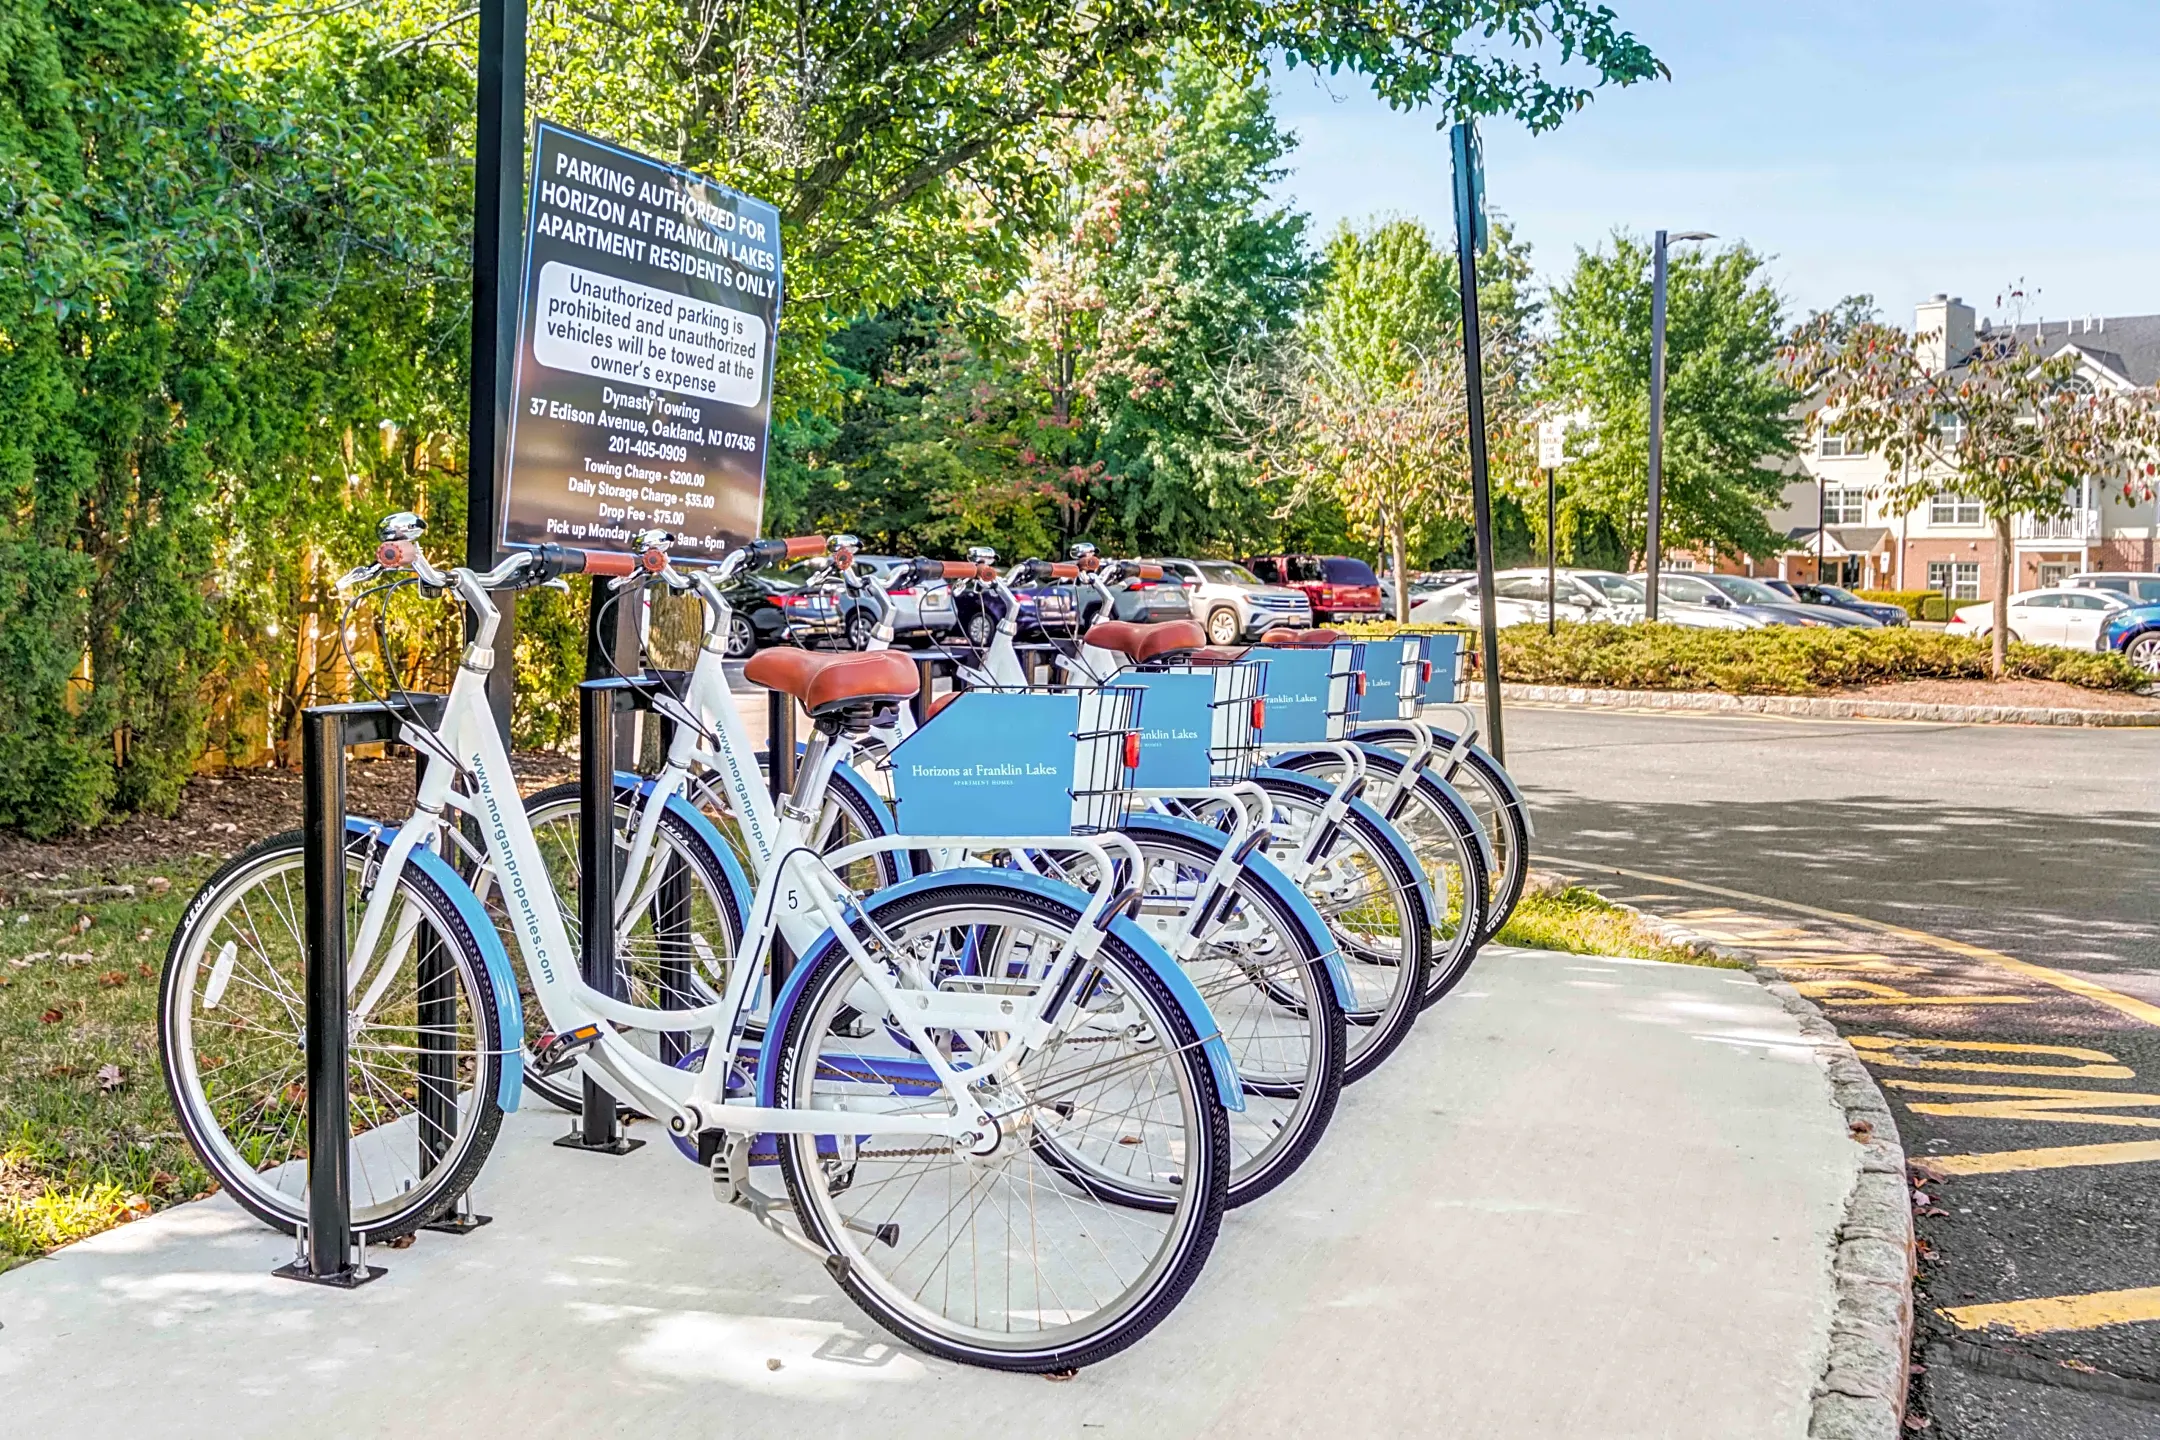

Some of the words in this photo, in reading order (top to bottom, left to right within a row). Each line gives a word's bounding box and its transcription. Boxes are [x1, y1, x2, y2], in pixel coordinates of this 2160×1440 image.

[556, 152, 636, 197] PARKING
[638, 180, 736, 232] AUTHORIZED
[738, 218, 766, 243] FOR
[541, 180, 625, 226] HORIZON
[628, 209, 652, 234] AT
[655, 216, 728, 257] FRANKLIN
[731, 241, 775, 272] LAKES
[537, 212, 646, 262] APARTMENT
[649, 246, 732, 287] RESIDENTS
[735, 271, 776, 299] ONLY
[570, 273, 673, 317] Unauthorized
[677, 304, 729, 336] parking
[733, 316, 743, 334] is
[548, 296, 631, 330] prohibited
[636, 312, 664, 337] and
[668, 321, 756, 358] unauthorized
[547, 321, 612, 349] vehicles
[618, 335, 644, 356] will
[649, 339, 666, 360] be
[671, 345, 714, 371] towed
[718, 358, 731, 374] at
[734, 359, 754, 379] the
[590, 355, 650, 380] owner's
[655, 368, 716, 393] expense
[603, 387, 655, 411] Dynasty
[657, 398, 700, 423] Towing
[529, 397, 546, 415] 37
[549, 401, 595, 424] Edison
[597, 413, 649, 436] Avenue,
[652, 421, 705, 446] Oakland,
[708, 429, 722, 446] NJ
[724, 433, 756, 451] 07436
[608, 436, 687, 462] 201-405-0909
[584, 457, 622, 479] Towing
[624, 464, 661, 484] Charge
[669, 469, 705, 487] $200.00
[568, 477, 595, 497] Daily
[598, 481, 638, 503] Storage
[641, 487, 677, 507] Charge
[685, 490, 715, 509] $35.00
[599, 503, 624, 521] Drop
[627, 506, 645, 521] Fee
[653, 508, 685, 525] $75.00
[547, 518, 569, 536] Pick
[571, 523, 586, 538] up
[589, 523, 630, 543] Monday
[677, 532, 698, 547] 9am
[705, 535, 725, 551] 6pm
[1266, 694, 1293, 704] ranklin
[1295, 693, 1318, 702] Lakes
[1372, 679, 1391, 687] Lakes
[1140, 729, 1169, 740] anklin
[1172, 729, 1198, 739] Lakes
[912, 764, 960, 777] Horizons
[963, 767, 973, 777] at
[976, 763, 1022, 776] Franklin
[1026, 762, 1057, 775] Lakes
[715, 720, 772, 862] www.morganproperti
[659, 820, 690, 846] ENDA
[472, 752, 556, 985] www.morganproperties.com
[184, 885, 215, 929] KENDA
[788, 889, 798, 910] 5
[1485, 903, 1508, 933] KENDA
[1466, 908, 1480, 947] KENDA
[781, 1046, 794, 1110] KENDA
